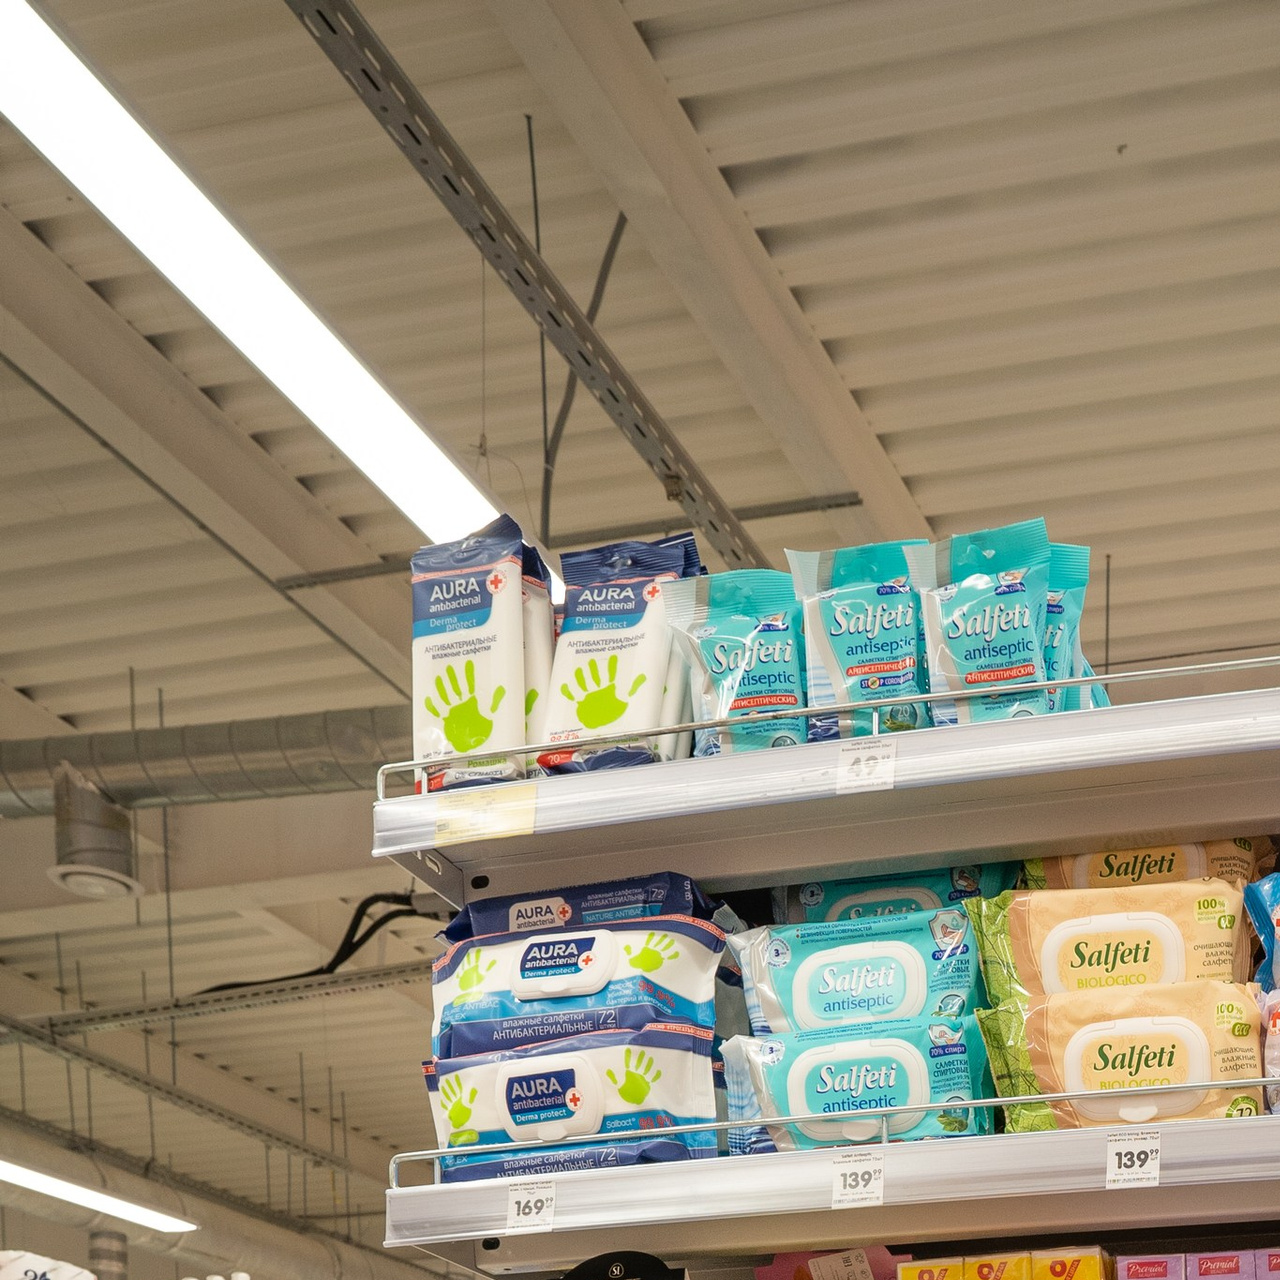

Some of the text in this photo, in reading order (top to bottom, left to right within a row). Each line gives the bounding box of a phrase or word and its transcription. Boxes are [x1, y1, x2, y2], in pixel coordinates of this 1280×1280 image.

[430, 578, 480, 601] AURA
[578, 587, 635, 602] AURA
[429, 595, 481, 612] antibacterial
[577, 601, 635, 611] antibacterial
[430, 617, 457, 626] Derma
[446, 619, 477, 632] protect
[830, 602, 914, 639] Salfeti
[948, 603, 1030, 641] Salfeti
[424, 635, 497, 653] АНТИБАКТЕРИАЛЬНЫЕ
[432, 645, 491, 659] влажные салфетки
[846, 635, 916, 656] antiseptic
[964, 638, 1034, 660] antiseptic
[711, 639, 793, 675] Salfeti
[966, 666, 1036, 682] АНТИСЕПТИЧЕСКИЕ
[516, 904, 554, 919] AURA
[528, 942, 578, 958] AURA
[1070, 940, 1151, 970] Salfeti
[525, 956, 577, 968] antibacterial
[524, 967, 575, 978] Derma protect
[817, 964, 896, 998] Salfeti
[1076, 973, 1147, 989] BIOLOGICO
[823, 991, 894, 1014] antiseptic
[503, 1010, 616, 1027] влажные салфетки 72
[493, 1021, 593, 1041] АНТИБАКТЕРИАЛЬНЫЕ
[1093, 1045, 1176, 1075] Salfeti
[815, 1063, 897, 1098] Salfeti
[1115, 1150, 1150, 1169] 139
[840, 1171, 871, 1190] 139
[514, 1199, 544, 1216] 169
